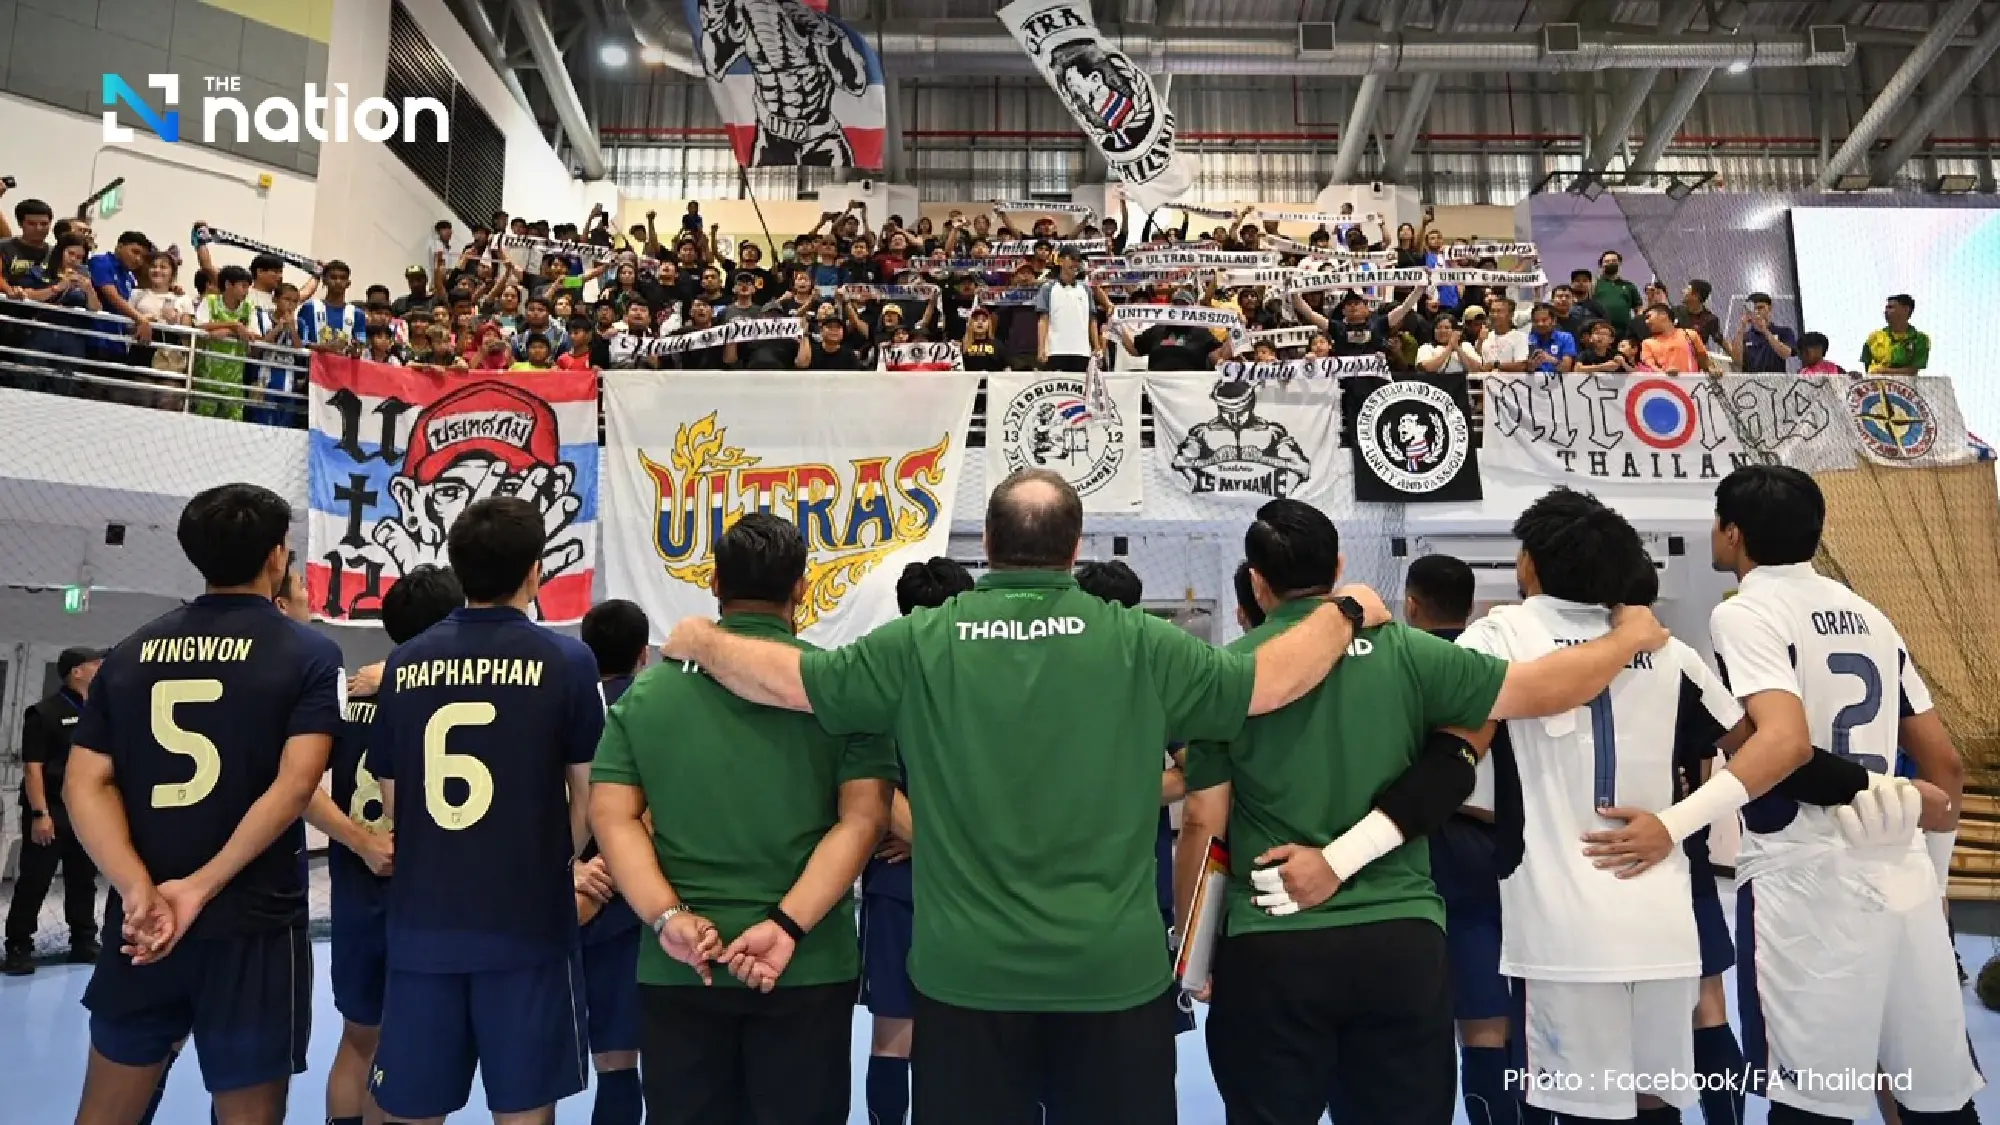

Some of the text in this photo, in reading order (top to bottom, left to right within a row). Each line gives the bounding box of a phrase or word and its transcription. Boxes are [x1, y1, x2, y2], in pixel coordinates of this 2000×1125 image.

[1145, 253, 1258, 264] ULTRAS THAILAND
[1292, 270, 1423, 289] LTRAS THAILAND
[1117, 308, 1163, 319] UNITY
[1181, 311, 1240, 324] PASSION
[638, 430, 950, 561] ULTRAS
[956, 616, 1086, 640] THAILAND
[139, 636, 253, 663] WINGWON
[396, 659, 543, 693] PRAPHAPHAN
[1826, 652, 1889, 775] 2
[151, 678, 223, 809] 5
[424, 702, 496, 831] 6
